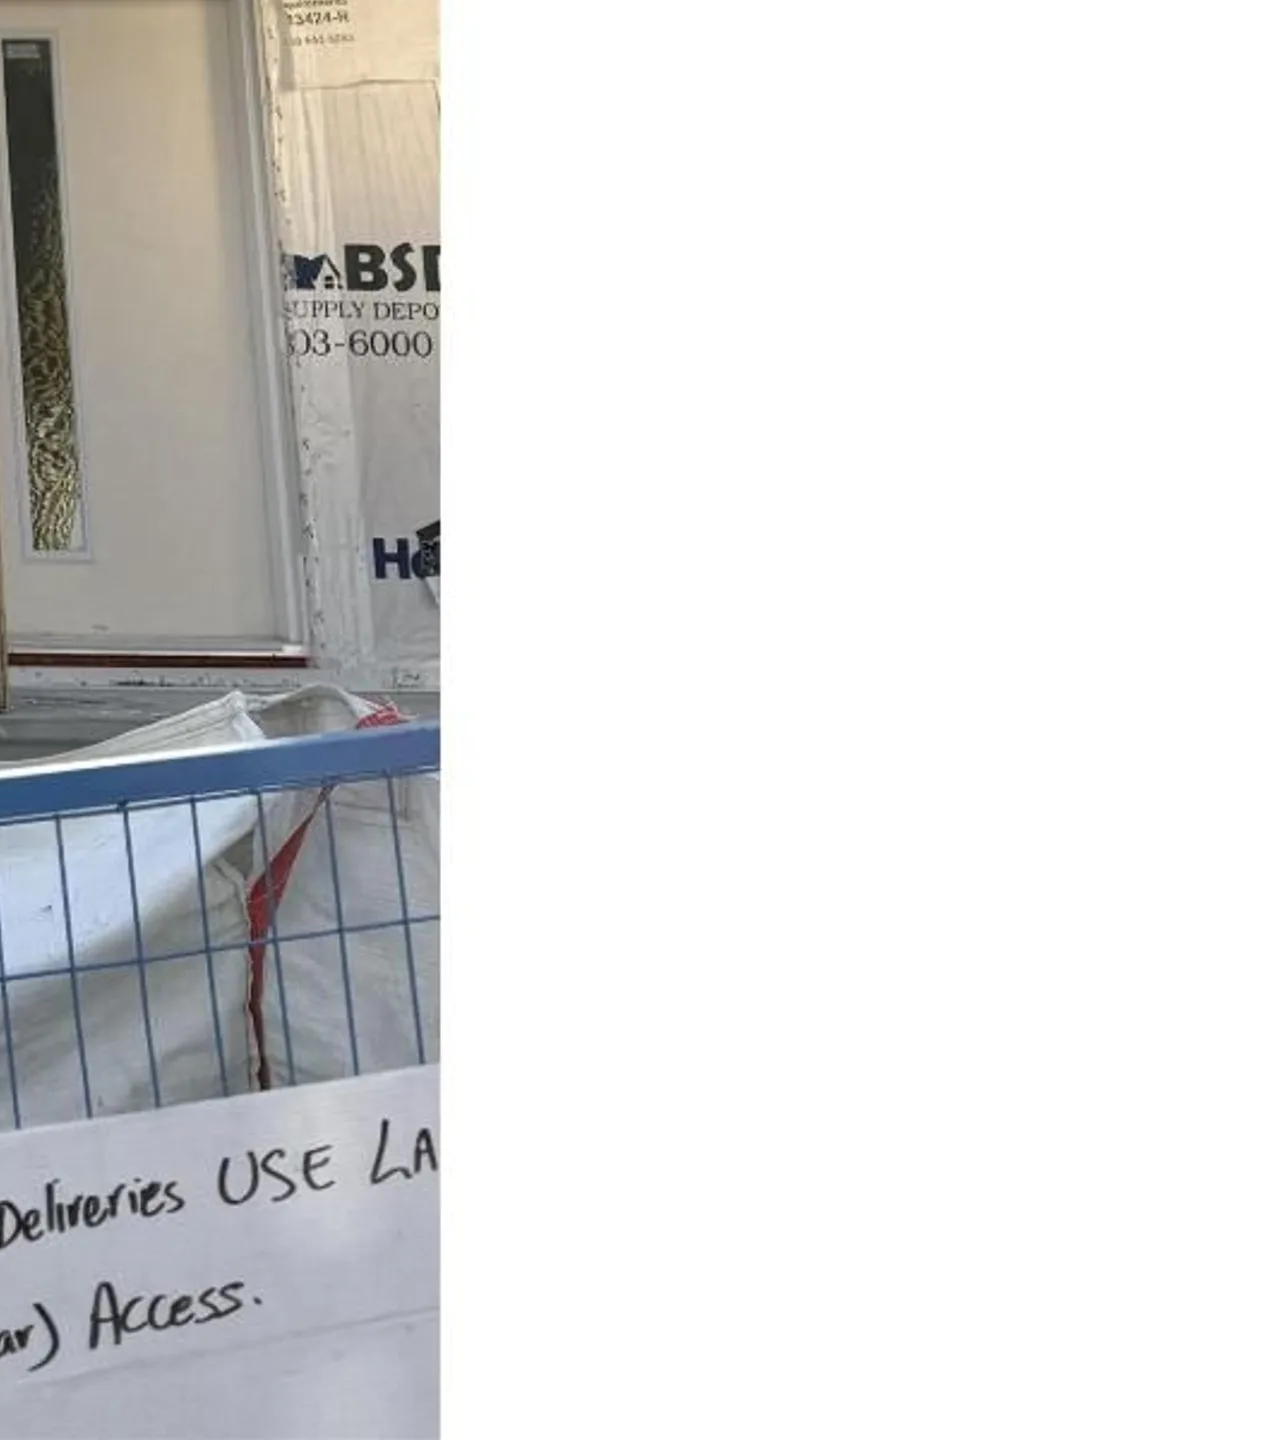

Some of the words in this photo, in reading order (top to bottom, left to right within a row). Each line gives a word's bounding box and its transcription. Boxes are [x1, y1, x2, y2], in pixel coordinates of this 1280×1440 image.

[287, 300, 364, 319] UPPLY
[288, 328, 433, 357] 03-6000
[218, 1144, 336, 1207] USE
[88, 1281, 264, 1351] Access.
